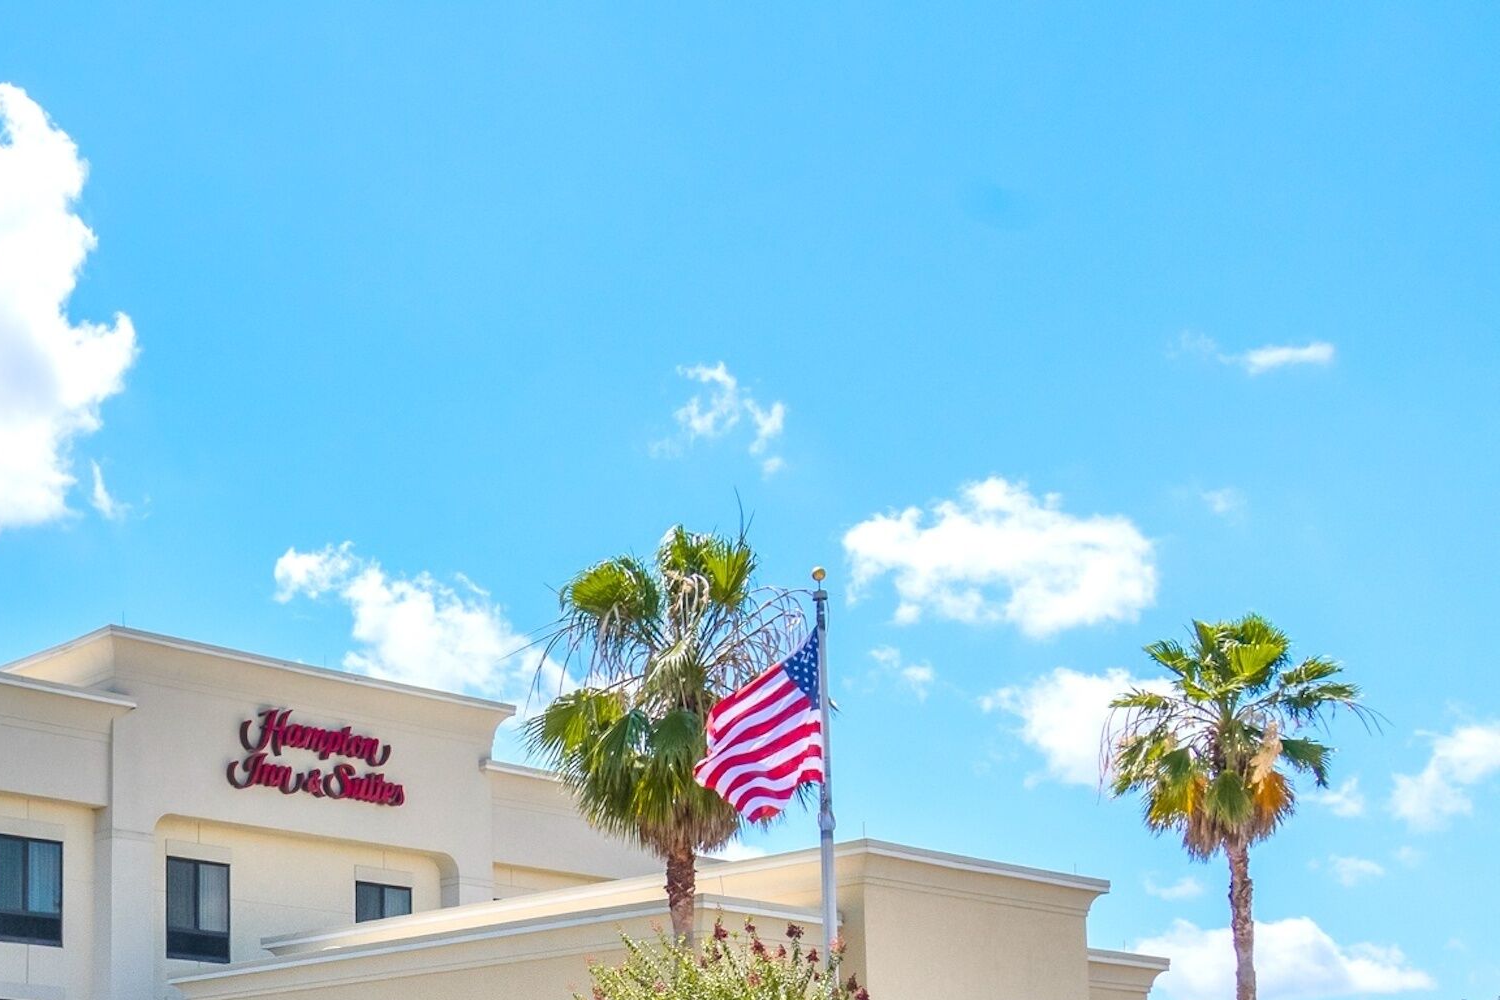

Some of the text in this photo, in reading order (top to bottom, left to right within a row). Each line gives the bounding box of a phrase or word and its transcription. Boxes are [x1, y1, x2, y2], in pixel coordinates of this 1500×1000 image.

[240, 709, 391, 767] Hampton
[227, 753, 405, 806] Inn & Suites
